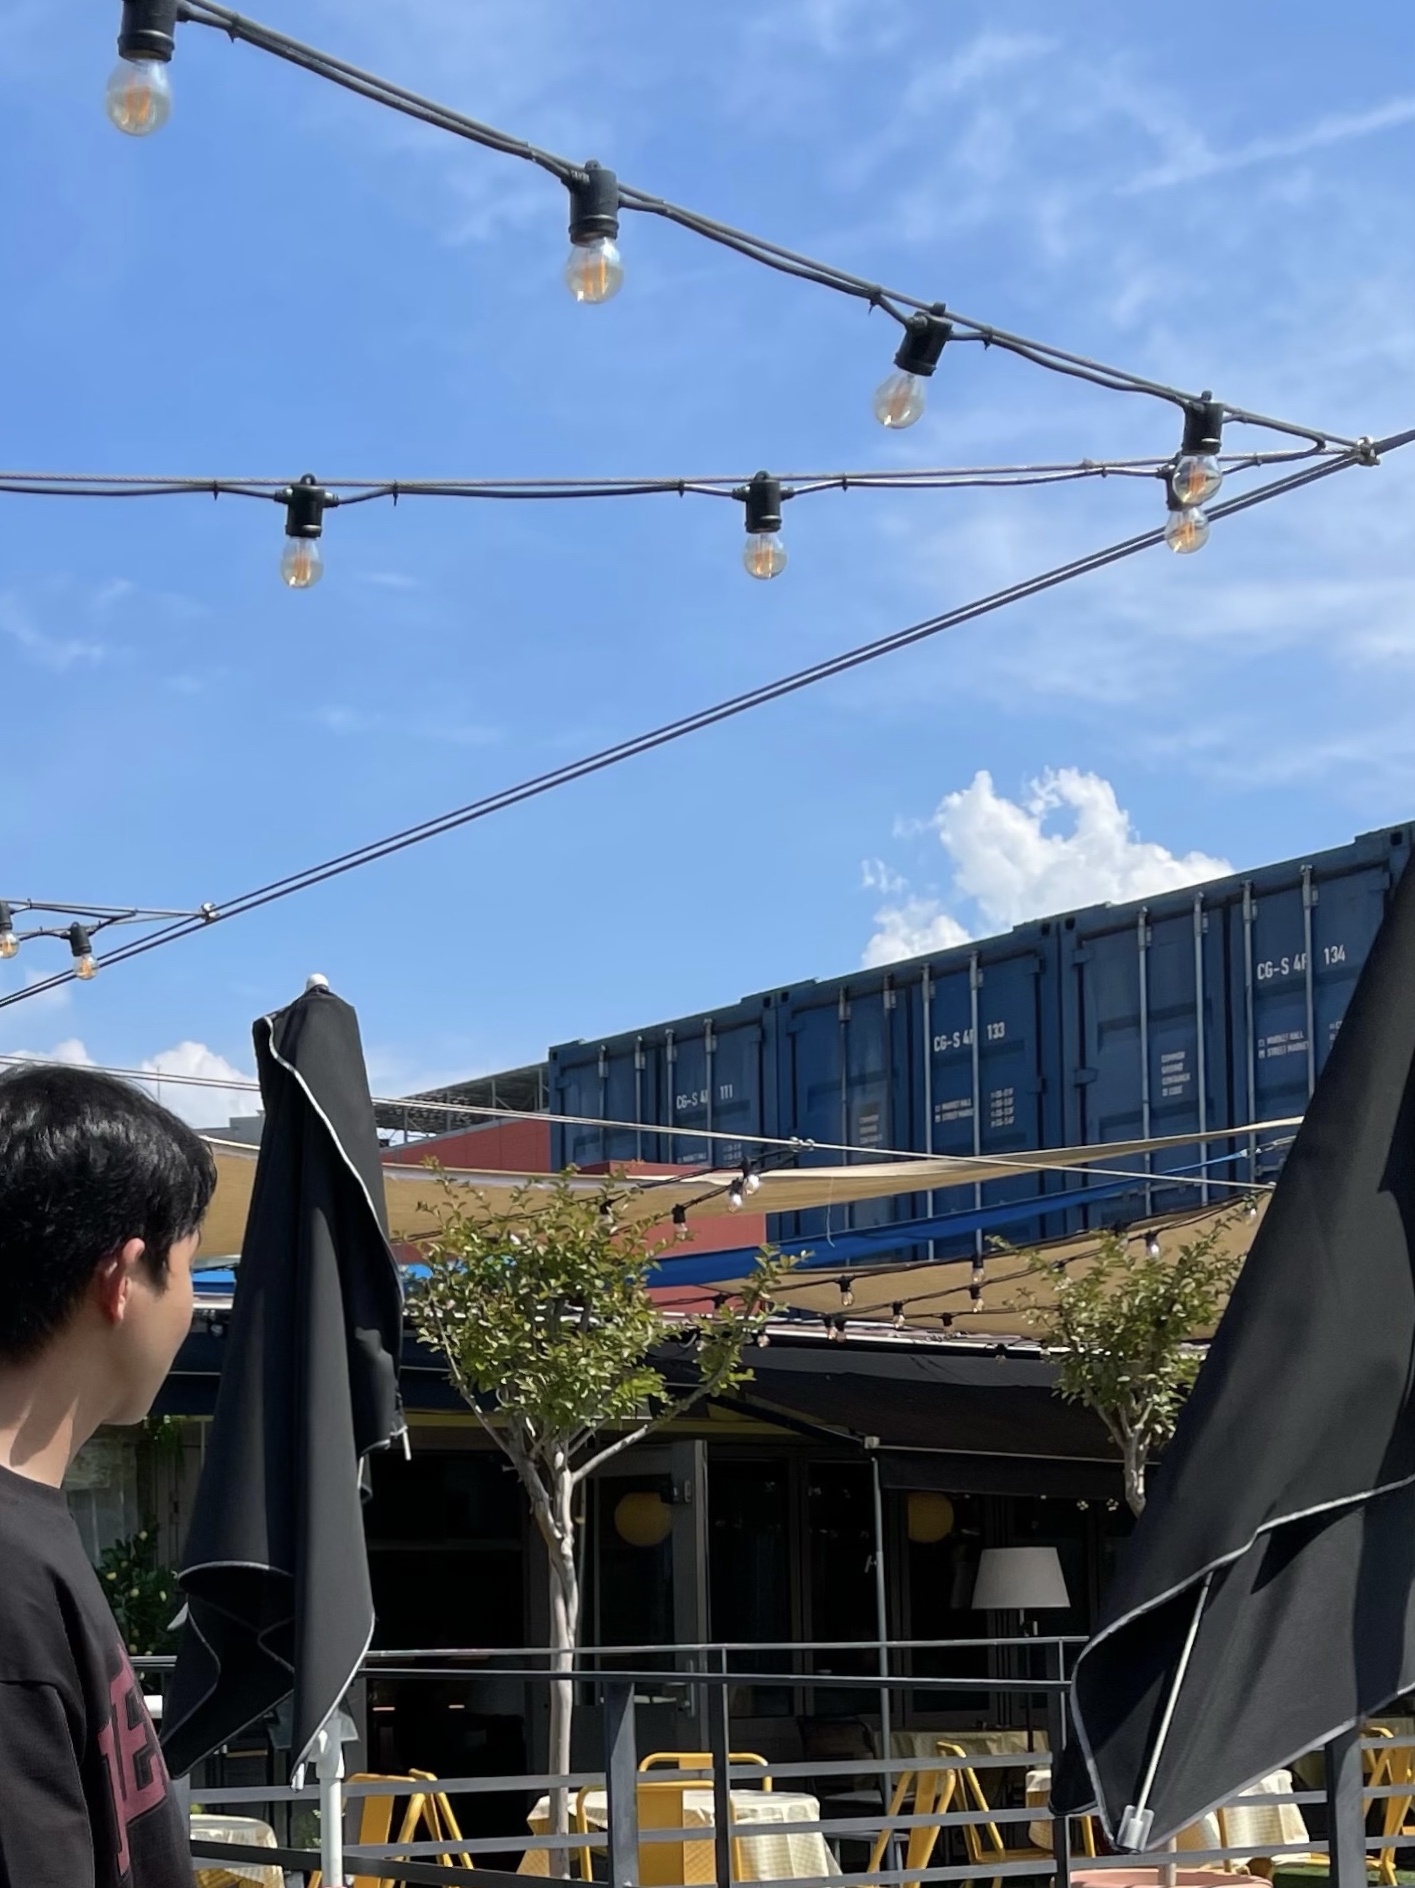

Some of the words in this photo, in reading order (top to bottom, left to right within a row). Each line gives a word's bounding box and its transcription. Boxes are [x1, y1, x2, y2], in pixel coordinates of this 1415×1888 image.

[1257, 957, 1289, 980] CG-S
[1324, 944, 1346, 965] 134
[933, 1031, 960, 1052] CG-S
[987, 1021, 1005, 1040] 133
[720, 1083, 733, 1100] 111
